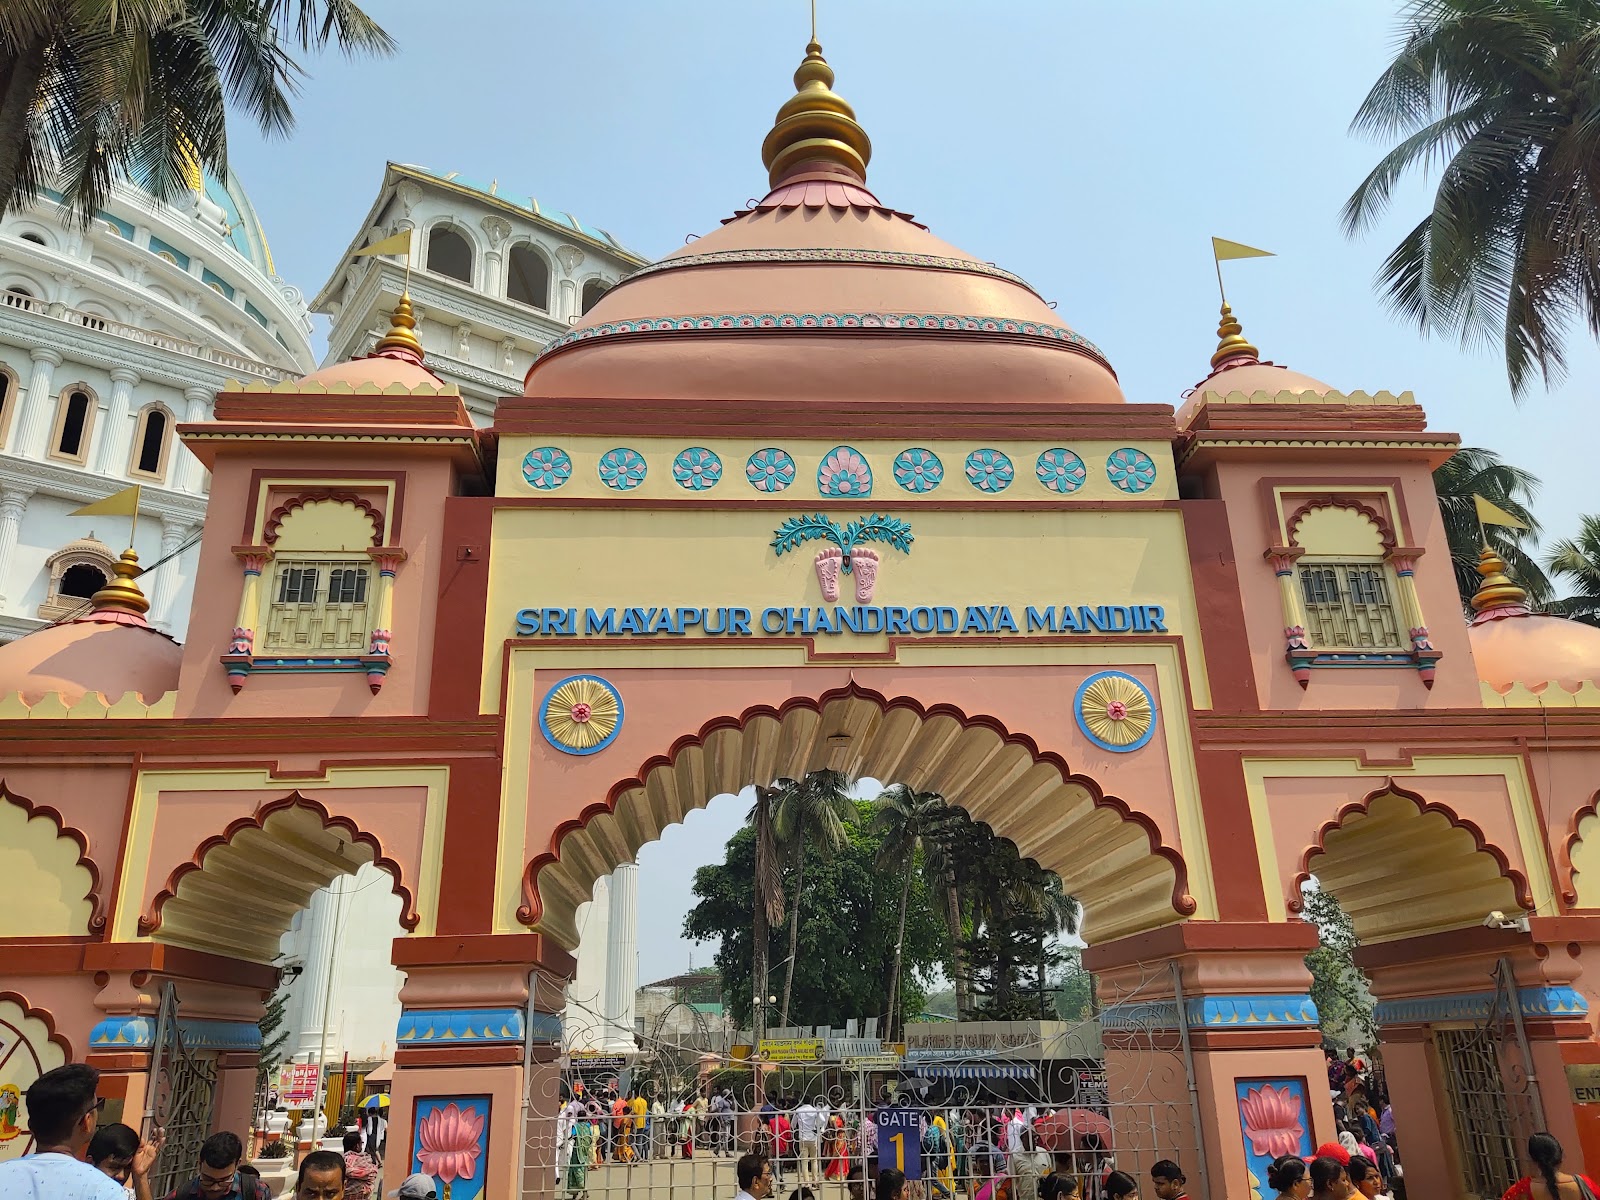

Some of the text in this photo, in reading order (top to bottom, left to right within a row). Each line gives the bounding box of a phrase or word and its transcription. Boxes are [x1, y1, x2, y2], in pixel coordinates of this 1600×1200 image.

[516, 605, 1168, 635] SRI MAYAPUR CHANDRODAYA MANDIR
[955, 1033, 998, 1049] ENQUIRY
[879, 1111, 918, 1127] GATE
[889, 1132, 905, 1174] 1
